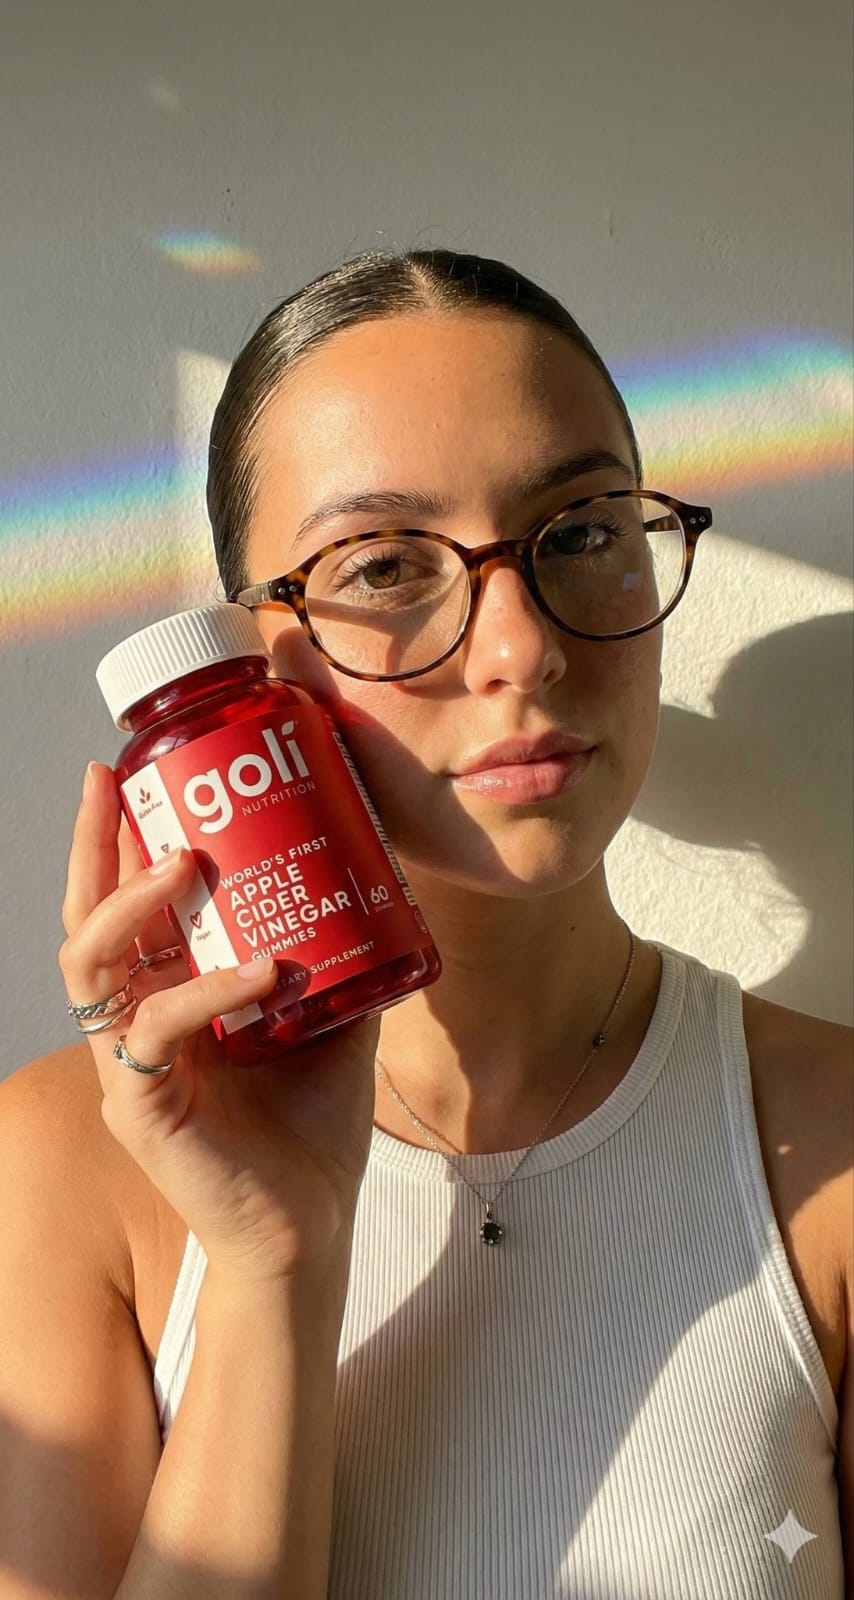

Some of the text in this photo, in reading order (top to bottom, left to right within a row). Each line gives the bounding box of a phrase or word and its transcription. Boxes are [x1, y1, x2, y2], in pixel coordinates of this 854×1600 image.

[183, 720, 310, 834] goli
[241, 780, 317, 817] NUTRITION
[219, 836, 329, 890] WORLD'S FIRST
[228, 862, 305, 907] APPLE
[235, 884, 309, 929] CIDER
[370, 885, 389, 904] 60
[242, 890, 352, 949] VINEGAR
[251, 926, 317, 962] GUMMIES
[309, 940, 376, 975] SUPPLEMENT
